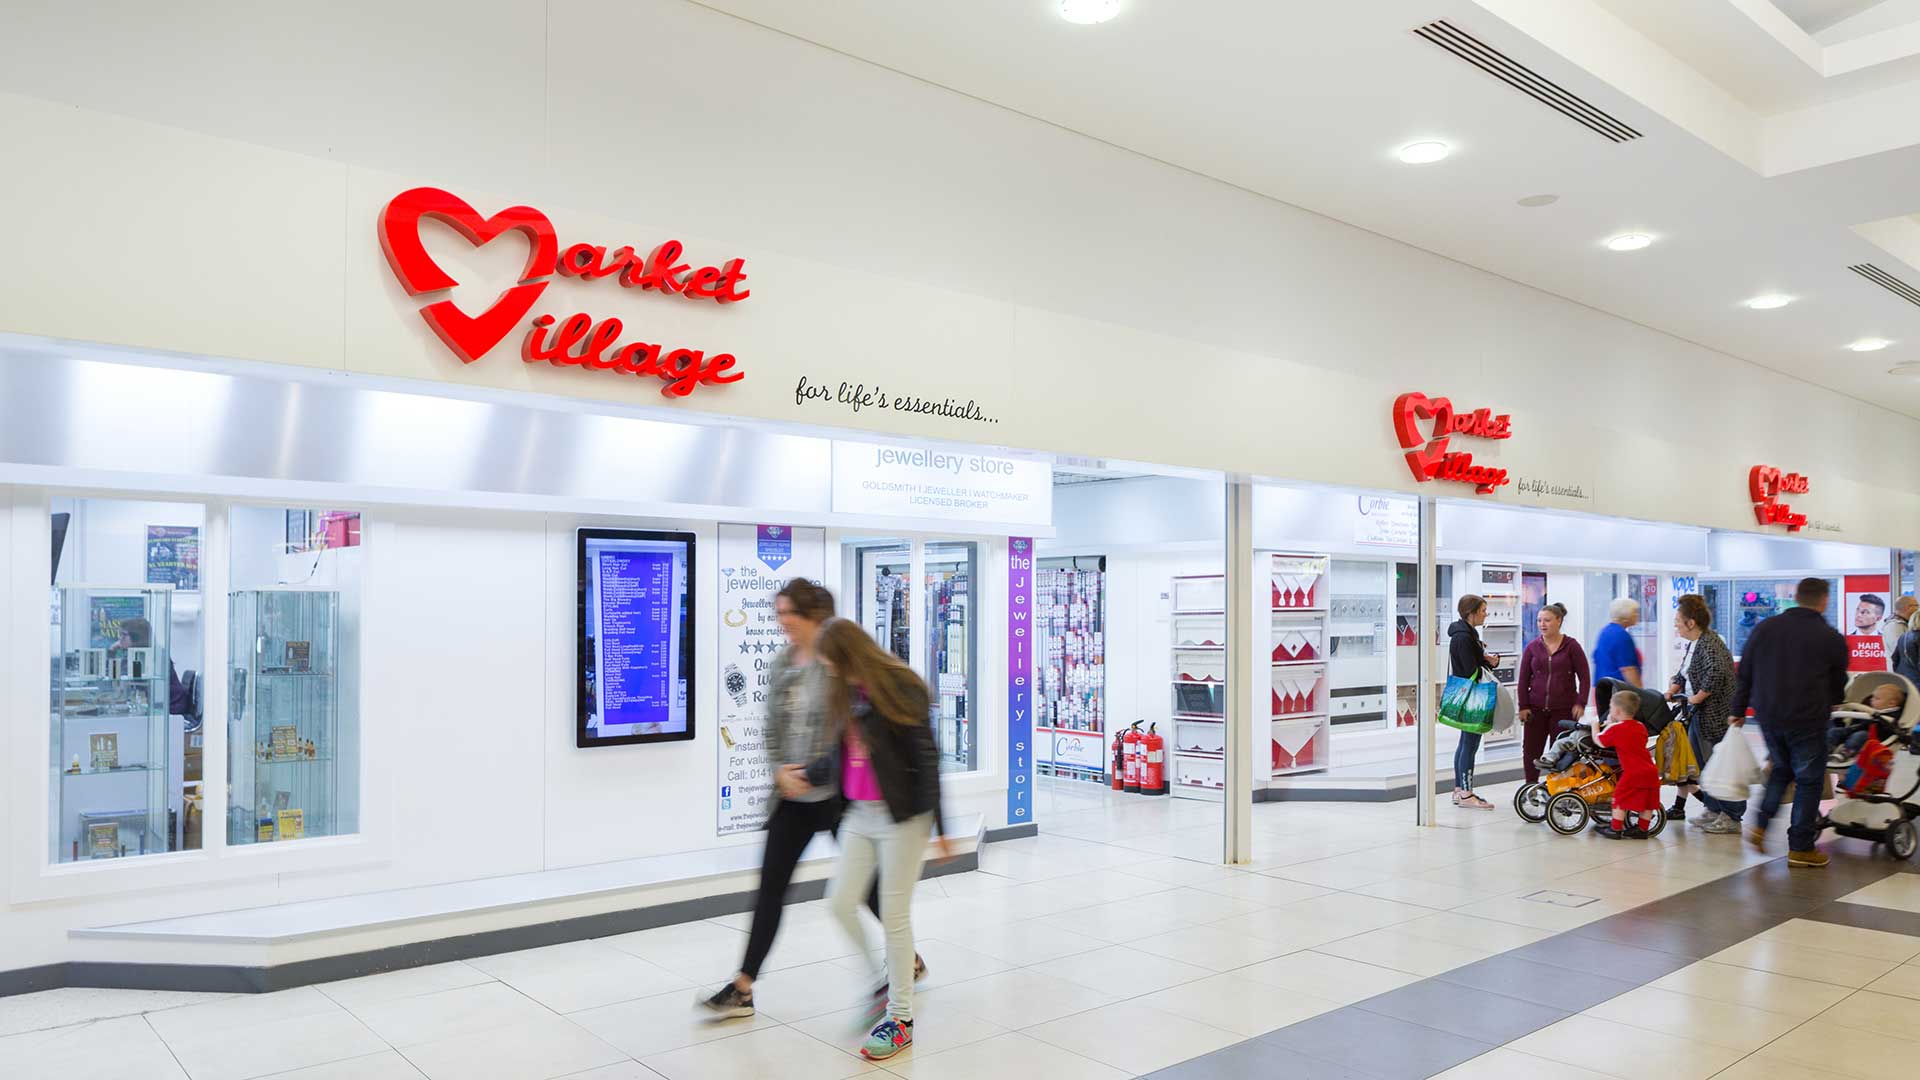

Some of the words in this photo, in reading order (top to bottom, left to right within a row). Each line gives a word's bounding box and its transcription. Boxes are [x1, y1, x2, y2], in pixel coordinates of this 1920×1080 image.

[796, 377, 832, 405] for
[838, 383, 889, 412] life's
[875, 449, 963, 475] jewellery
[970, 457, 1014, 475] store
[862, 480, 916, 493] GOLDSMITH
[909, 496, 952, 507] LICENSED
[954, 499, 988, 509] BROKER
[1011, 555, 1029, 570] the
[740, 566, 757, 577] the
[726, 576, 786, 593] jewellery
[1858, 642, 1880, 650] HAIR
[1852, 650, 1887, 658] DESIGN
[743, 727, 758, 737] We
[729, 756, 745, 766] For
[727, 770, 747, 781] Call:
[1015, 741, 1025, 817] store
